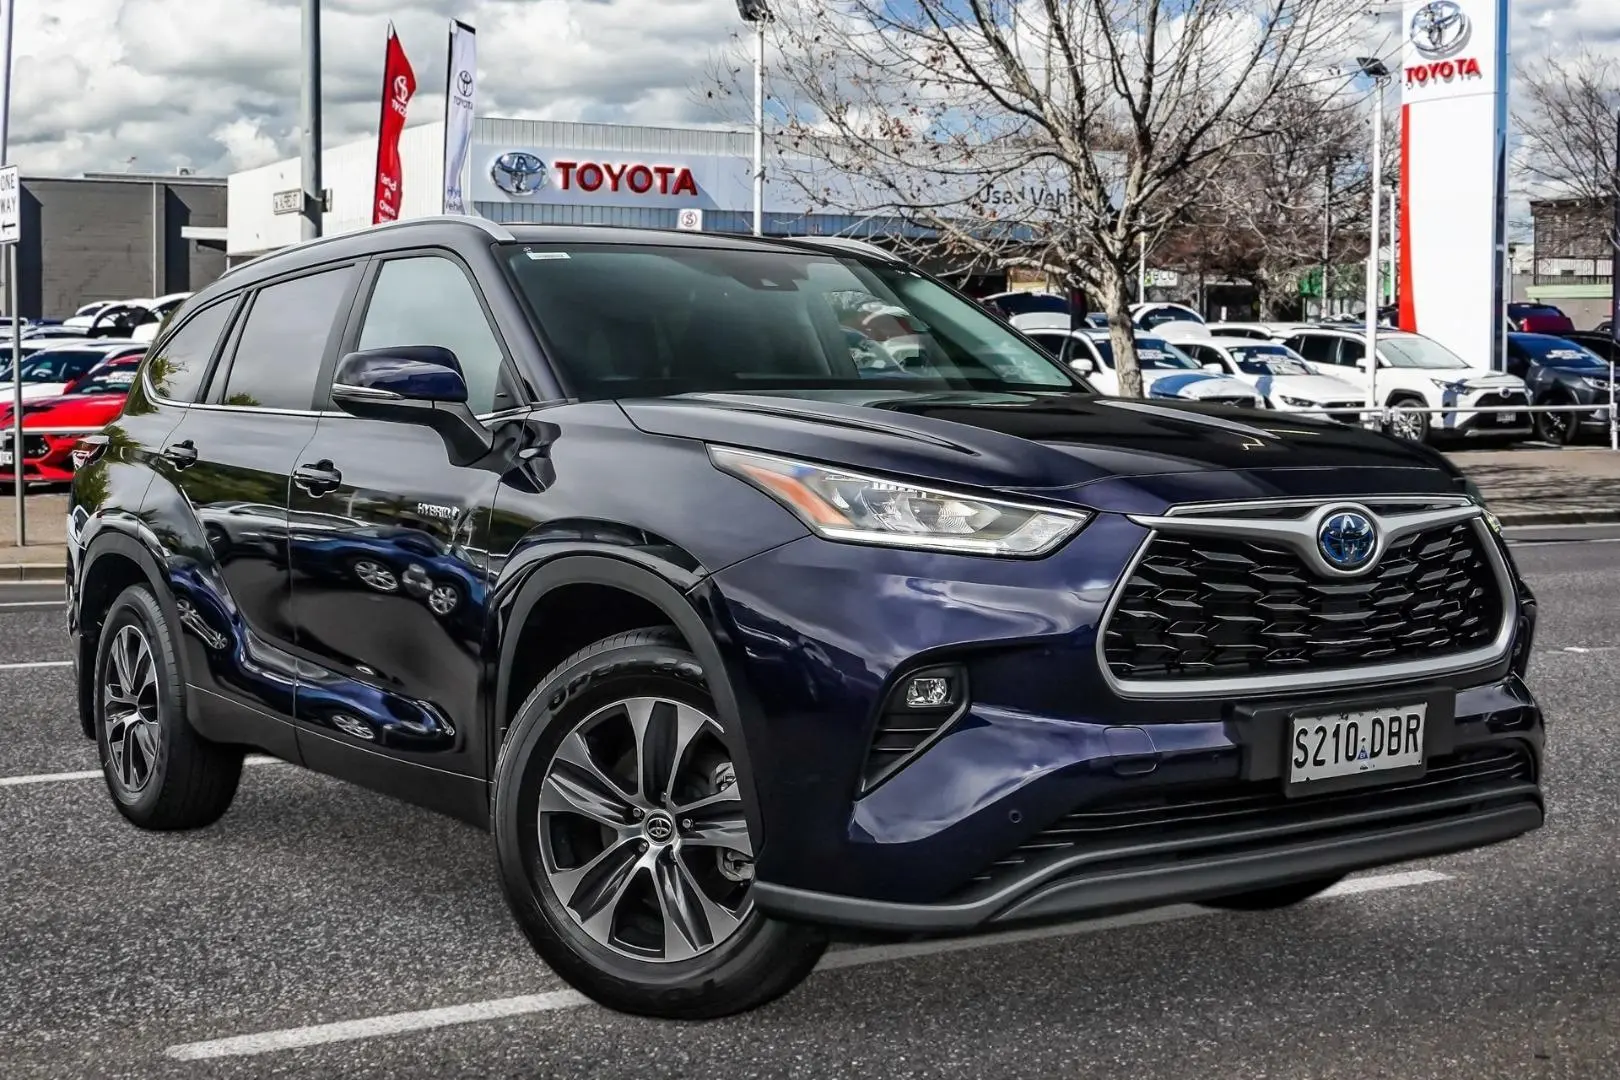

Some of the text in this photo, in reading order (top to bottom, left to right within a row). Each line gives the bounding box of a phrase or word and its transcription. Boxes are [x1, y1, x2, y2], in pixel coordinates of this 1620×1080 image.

[1404, 58, 1481, 83] TOYOTA
[453, 96, 473, 110] TOYOTA
[1, 173, 15, 191] ONE
[555, 161, 698, 196] TOYOTA
[0, 196, 16, 214] WAY
[417, 502, 451, 519] HYBRID
[1294, 713, 1421, 769] S210 DBR
